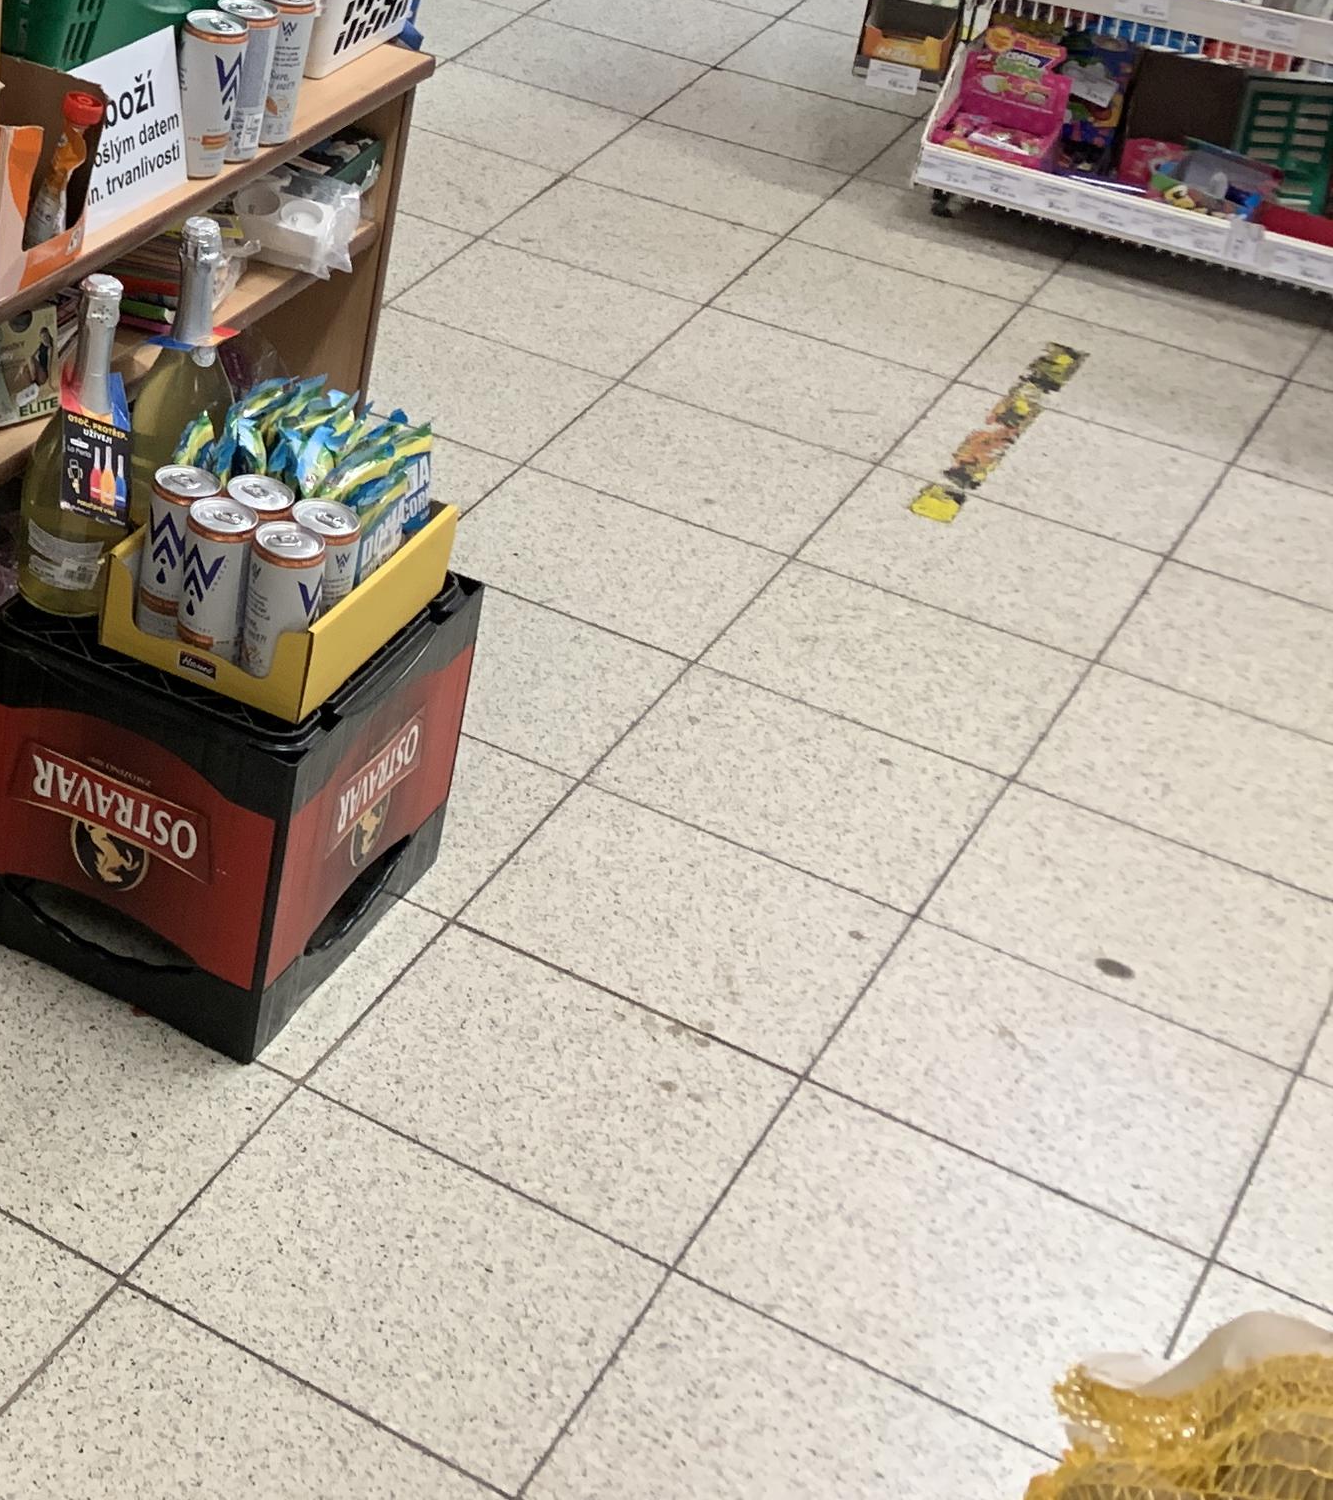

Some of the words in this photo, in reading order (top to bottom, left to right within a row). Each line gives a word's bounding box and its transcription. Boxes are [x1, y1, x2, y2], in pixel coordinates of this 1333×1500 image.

[105, 69, 156, 128] boží
[94, 135, 136, 169] ošlým
[139, 112, 180, 146] datem
[106, 141, 181, 196] trvanlivosti
[19, 396, 59, 417] ELITE
[32, 754, 199, 861] OSTRAVAR
[337, 723, 421, 835] OSTRAVAR
